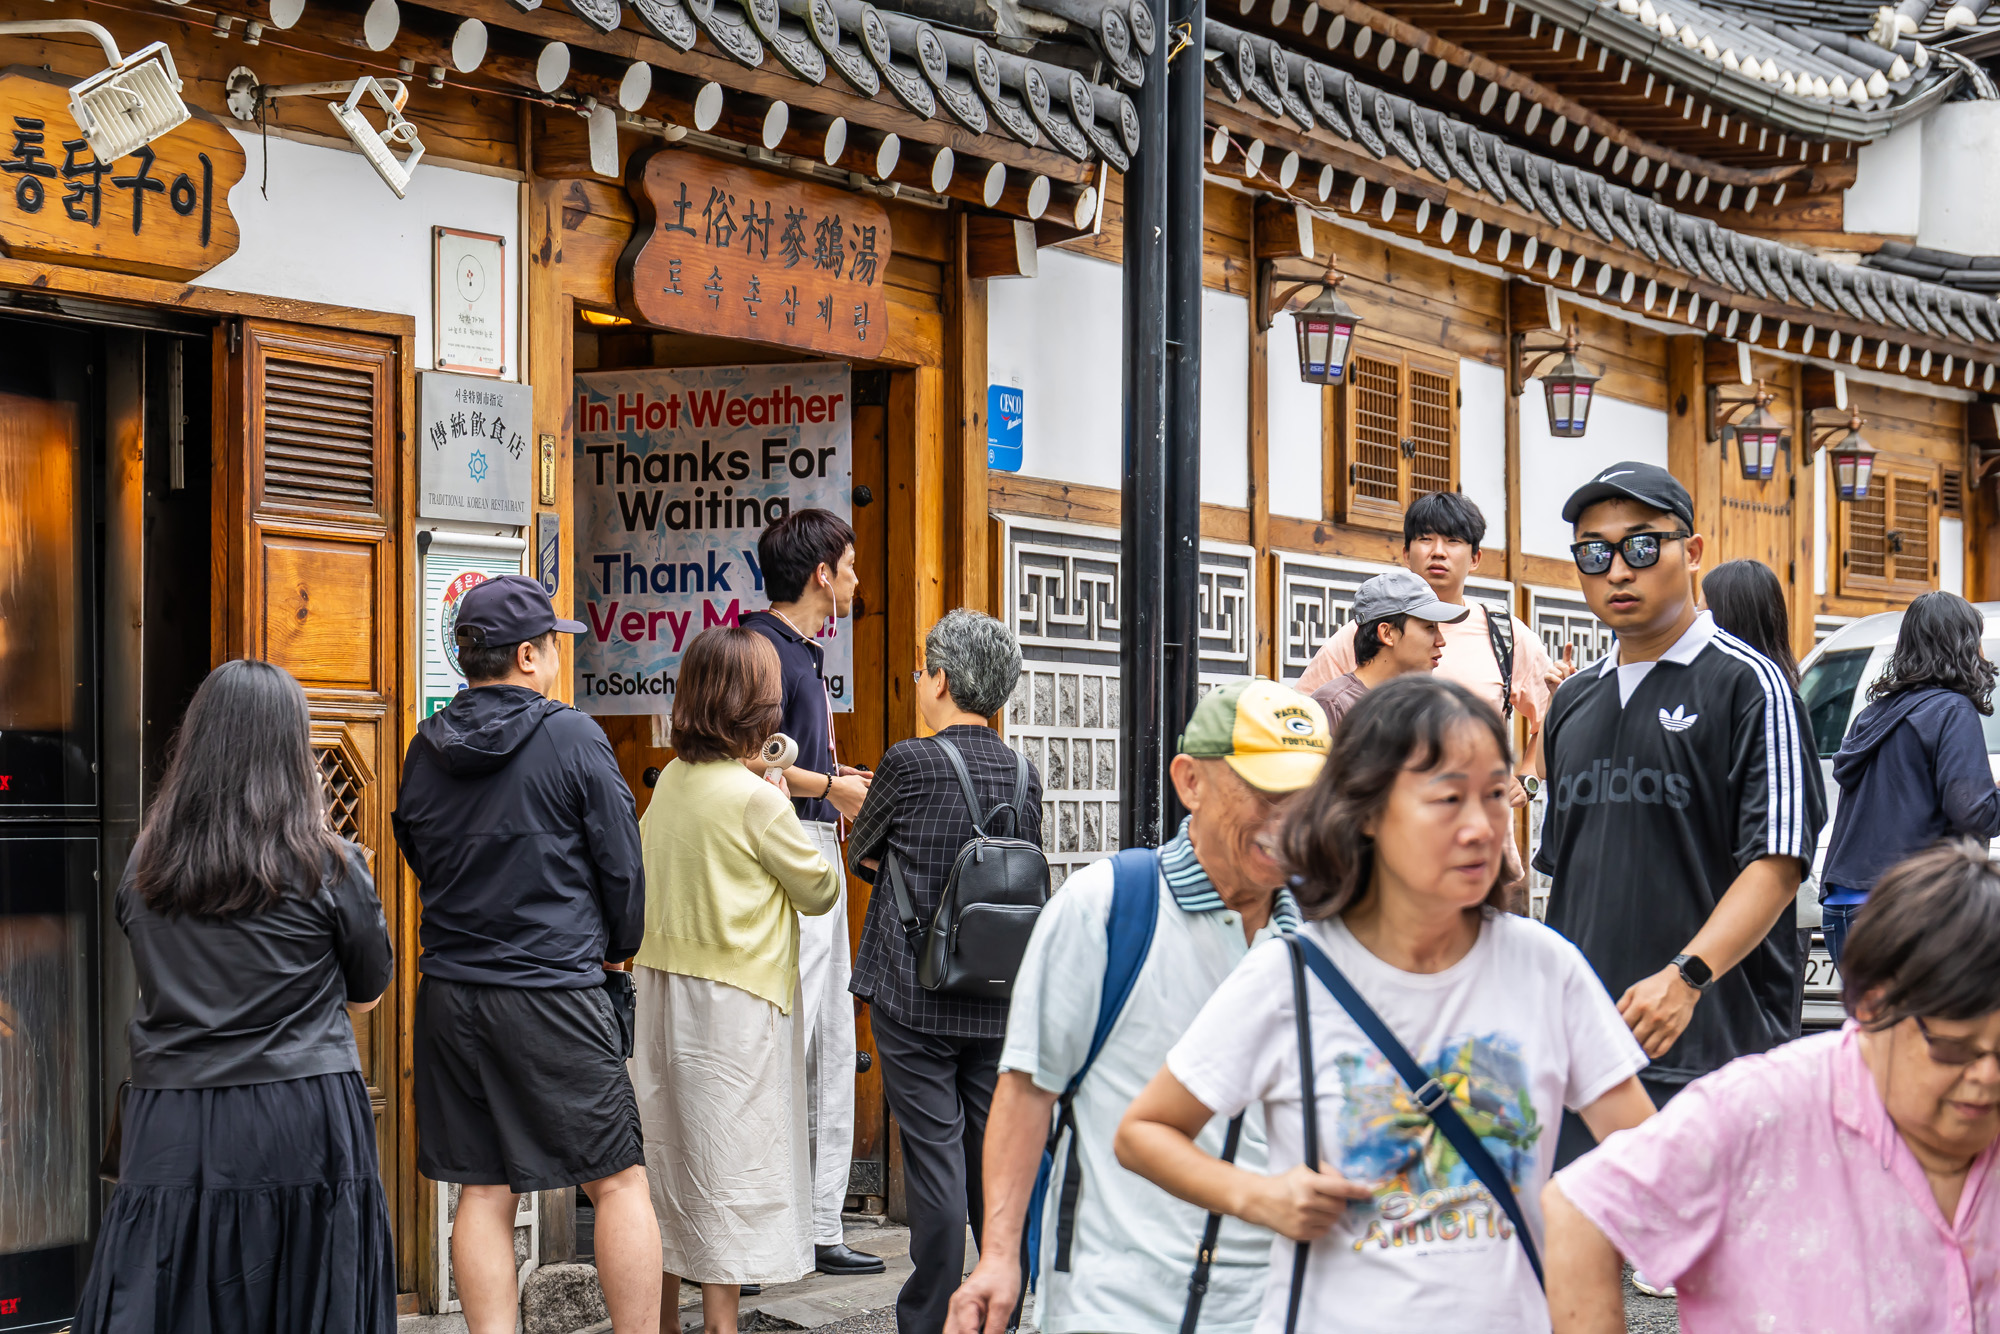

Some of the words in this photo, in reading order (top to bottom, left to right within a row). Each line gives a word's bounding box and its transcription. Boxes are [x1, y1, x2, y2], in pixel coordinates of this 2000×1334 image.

[0, 116, 213, 248] 통닭구이
[579, 394, 609, 433] In
[617, 392, 682, 431] Hot
[687, 384, 844, 429] Weather
[1000, 392, 1022, 414] CESCO
[429, 410, 526, 461] 傳統飲食店
[585, 439, 751, 486] Thanks
[761, 437, 837, 480] For
[428, 492, 465, 508] TRADITIONAL
[467, 496, 490, 510] KOREAN
[490, 498, 525, 513] RESTAURANT
[453, 572, 485, 594] 좋은식
[593, 549, 732, 595] Thank
[586, 600, 692, 653] Very
[581, 671, 680, 697] ToSokch
[1556, 756, 1692, 812] adidas
[1352, 1202, 1515, 1252] Americ
